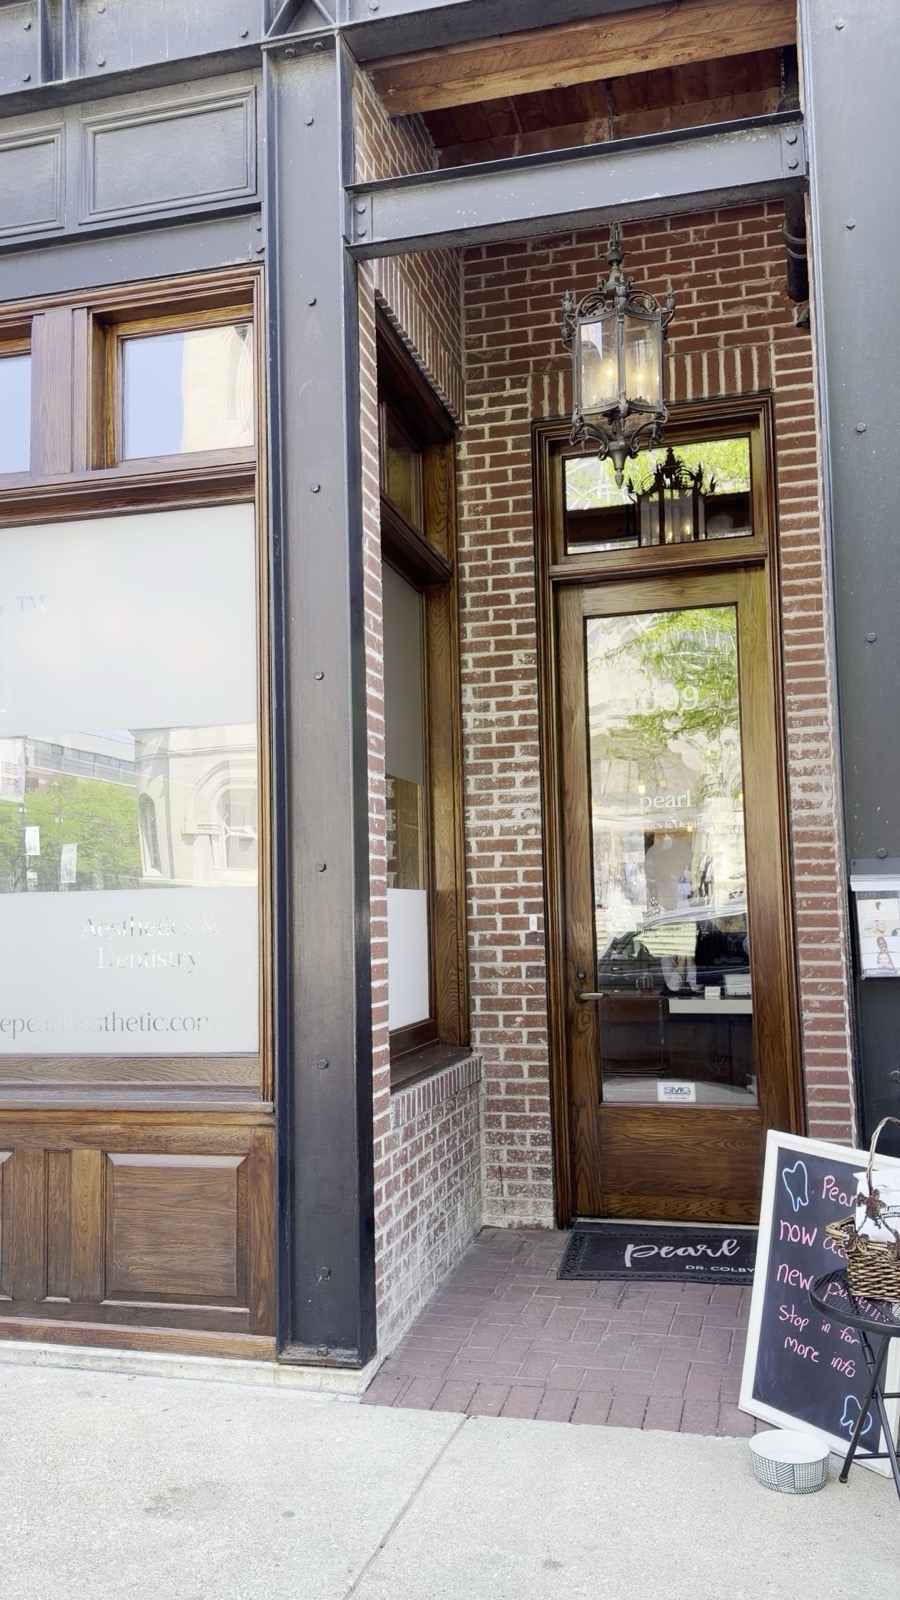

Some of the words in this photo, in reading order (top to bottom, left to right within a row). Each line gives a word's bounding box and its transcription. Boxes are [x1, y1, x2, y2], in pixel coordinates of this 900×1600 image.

[16, 594, 47, 612] TM
[639, 790, 692, 815] pearl
[81, 917, 193, 938] Aesthetics
[201, 913, 220, 935] &
[98, 948, 200, 974] Dentistry
[822, 1175, 858, 1207] Pear
[780, 1220, 818, 1247] now
[624, 1239, 740, 1267] pearl
[777, 1264, 814, 1291] new
[779, 1304, 809, 1332] Stop
[821, 1320, 831, 1333] in
[840, 1327, 860, 1344] for
[830, 1351, 856, 1378] info
